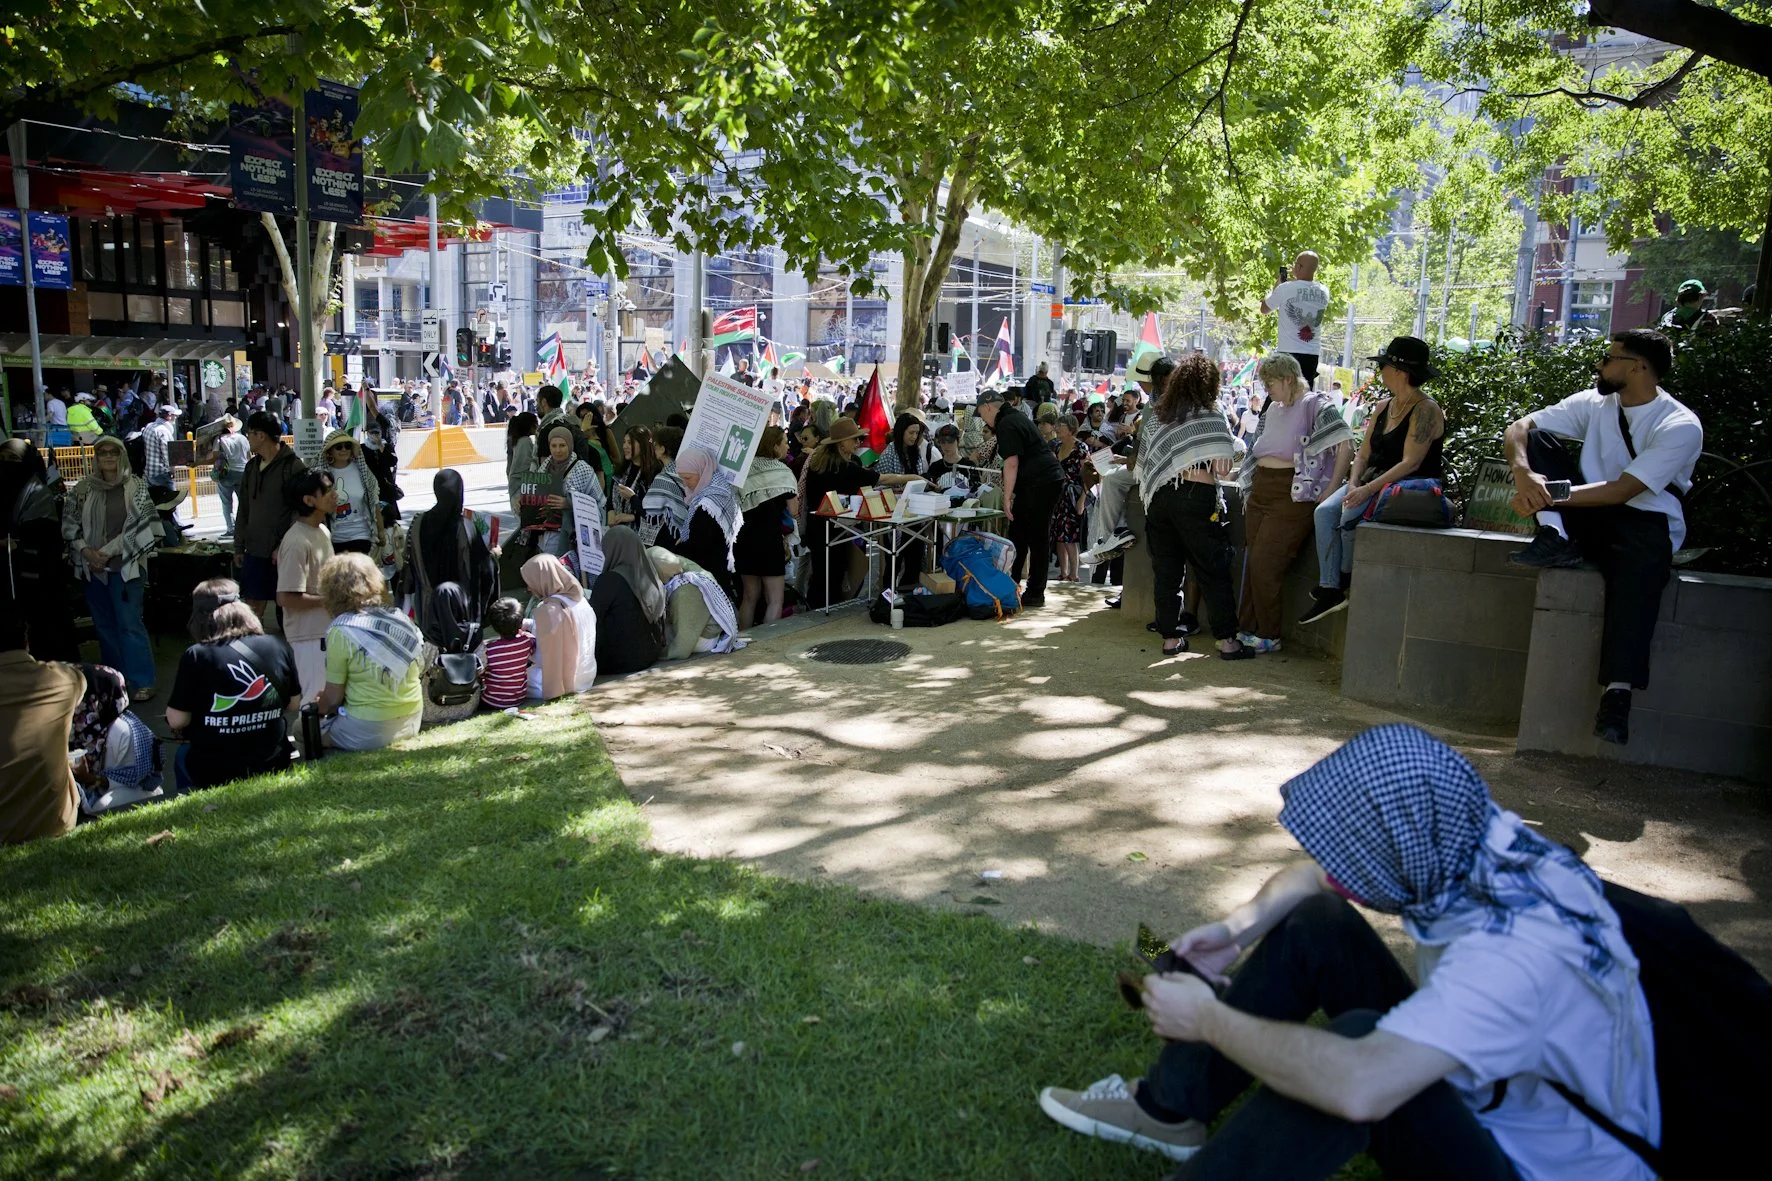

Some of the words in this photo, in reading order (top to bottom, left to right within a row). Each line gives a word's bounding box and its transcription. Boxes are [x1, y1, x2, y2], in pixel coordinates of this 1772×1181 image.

[244, 155, 282, 169] EXPECT
[240, 162, 287, 178] NOTHING
[315, 167, 355, 181] EXPECT
[251, 172, 277, 184] LESS
[311, 175, 359, 191] NOTHING
[322, 186, 347, 198] LESS
[35, 263, 68, 272] NOTHING
[37, 259, 65, 267] EXPECT
[424, 330, 437, 339] ONLY
[1223, 361, 1246, 371] KFC
[705, 383, 719, 393] YOUR
[719, 389, 738, 400] RIGHTS
[744, 400, 764, 412] SCHOOL
[706, 376, 737, 393] PALESTINE
[736, 388, 770, 406] SOLIDARITY
[520, 472, 552, 484] HANDS
[1483, 467, 1506, 483] HOW
[521, 483, 537, 494] OFF
[1475, 485, 1508, 502] CLAIM
[204, 716, 229, 726] FREE
[231, 708, 282, 726] PALESTINE
[219, 723, 267, 734] MELBOURNE
